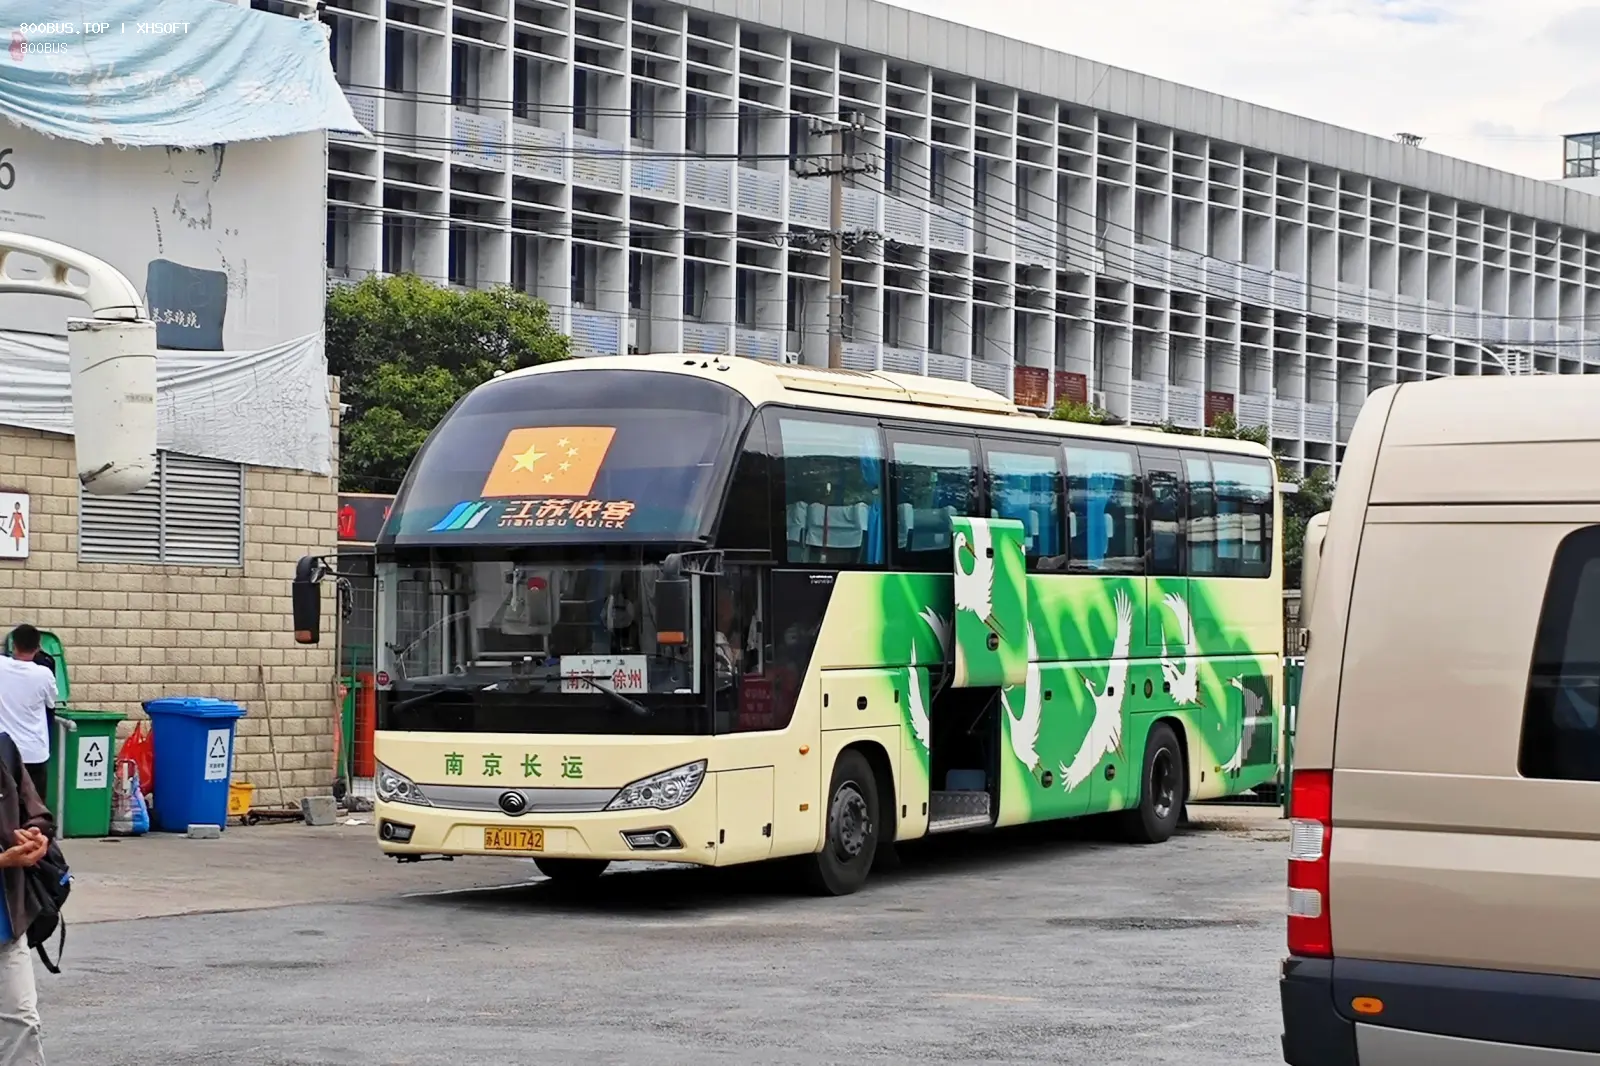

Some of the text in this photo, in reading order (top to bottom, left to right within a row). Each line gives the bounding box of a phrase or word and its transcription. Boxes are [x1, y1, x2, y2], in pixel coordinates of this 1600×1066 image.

[500, 499, 635, 521] 江苏快客
[612, 668, 642, 690] 徐州
[444, 752, 583, 779] 南京长运
